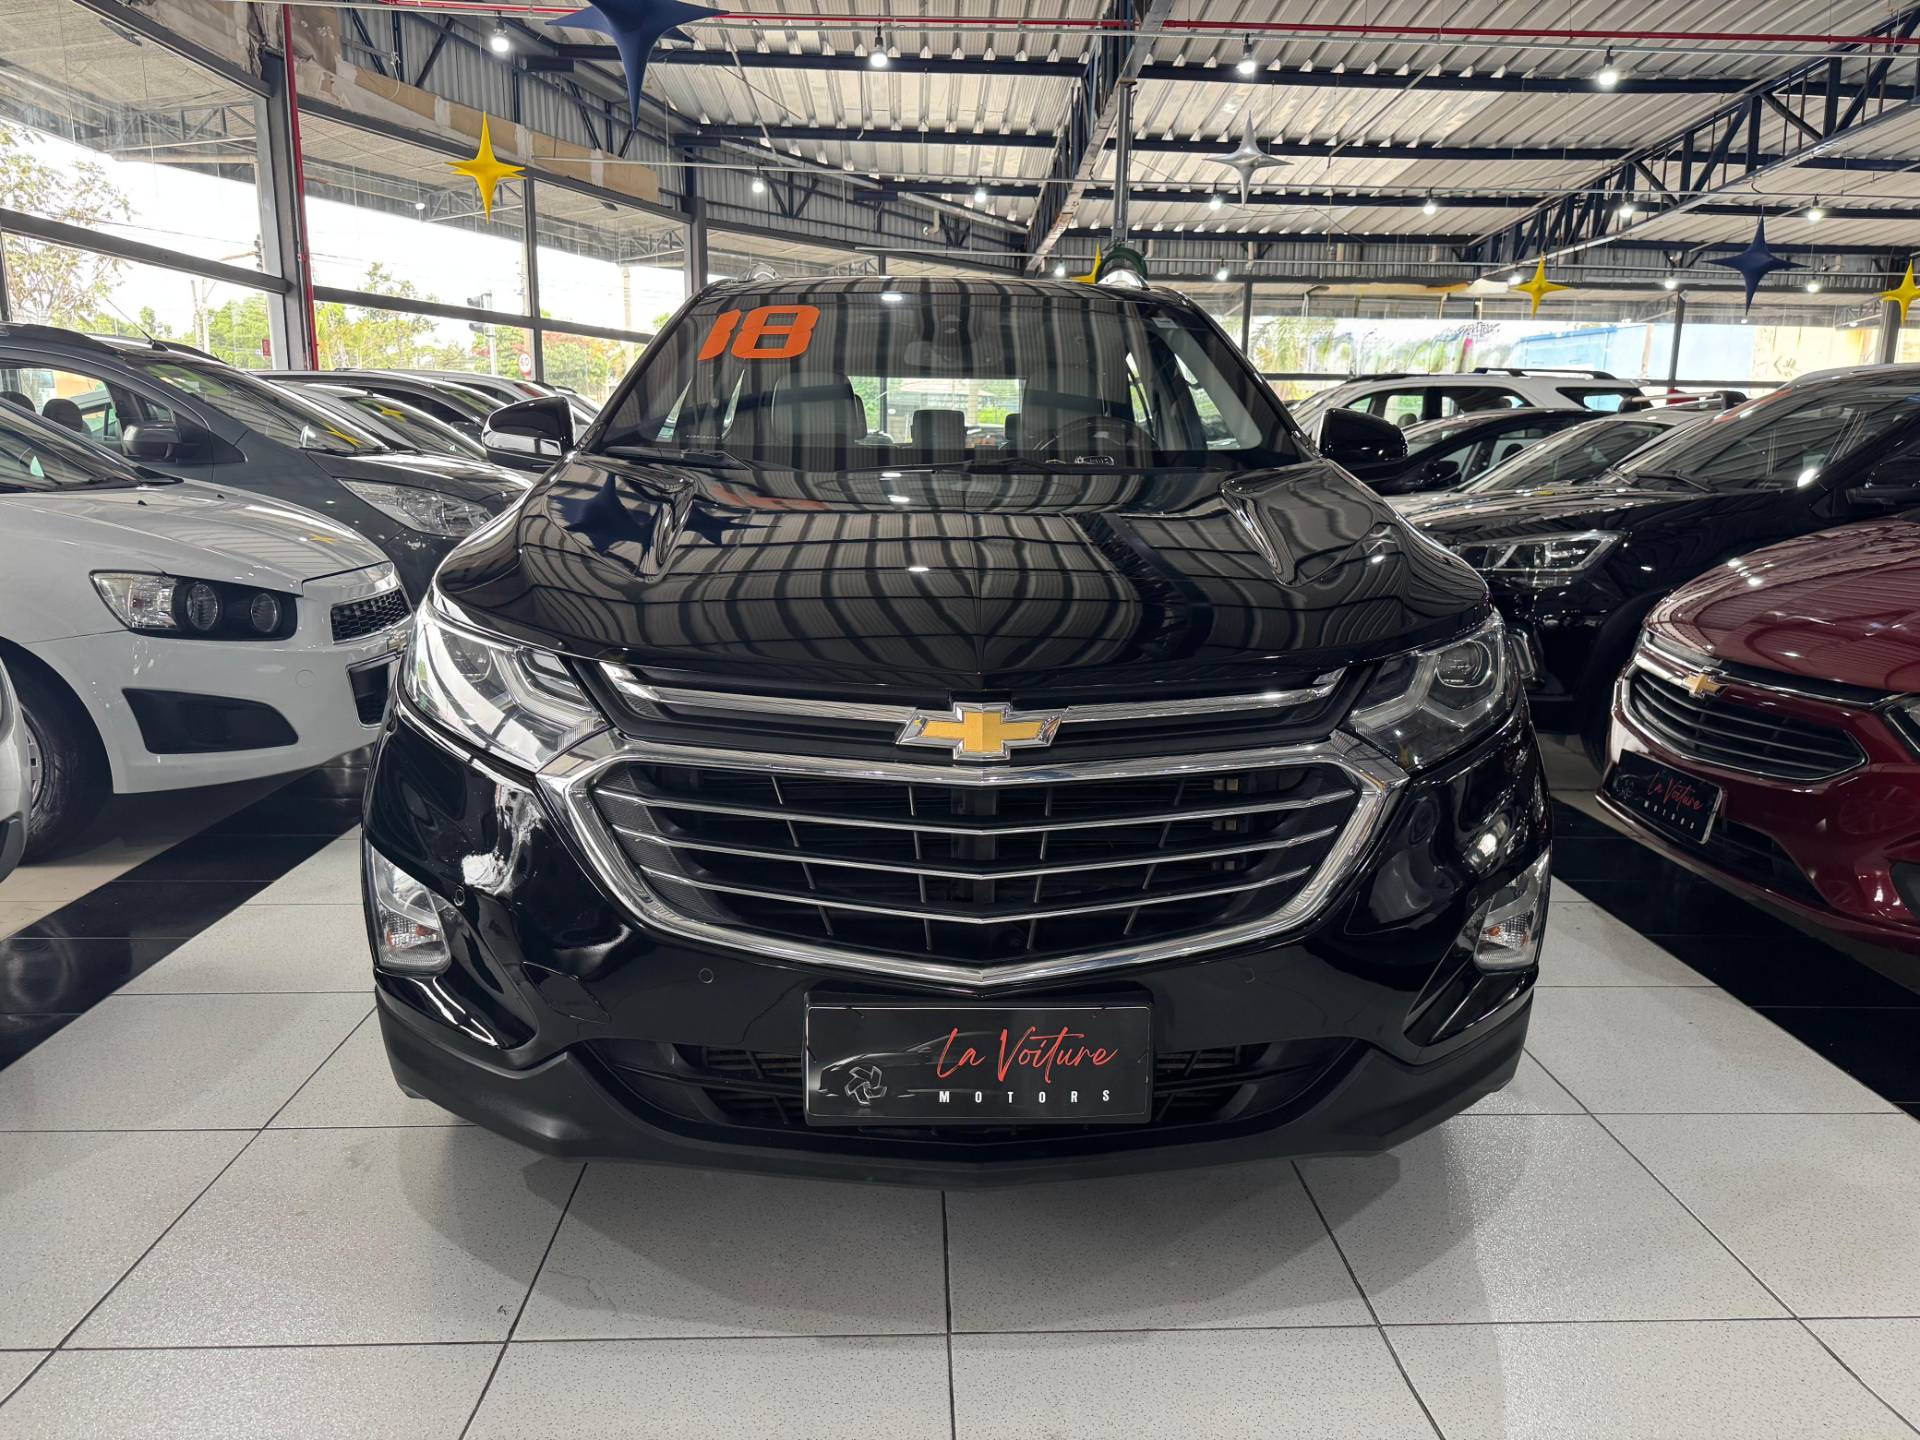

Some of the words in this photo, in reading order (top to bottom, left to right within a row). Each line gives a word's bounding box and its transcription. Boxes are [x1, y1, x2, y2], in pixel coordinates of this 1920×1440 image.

[697, 305, 820, 360] 18
[936, 1027, 986, 1079] La
[997, 1025, 1119, 1083] Voiture
[938, 1089, 1111, 1103] MOTORS
